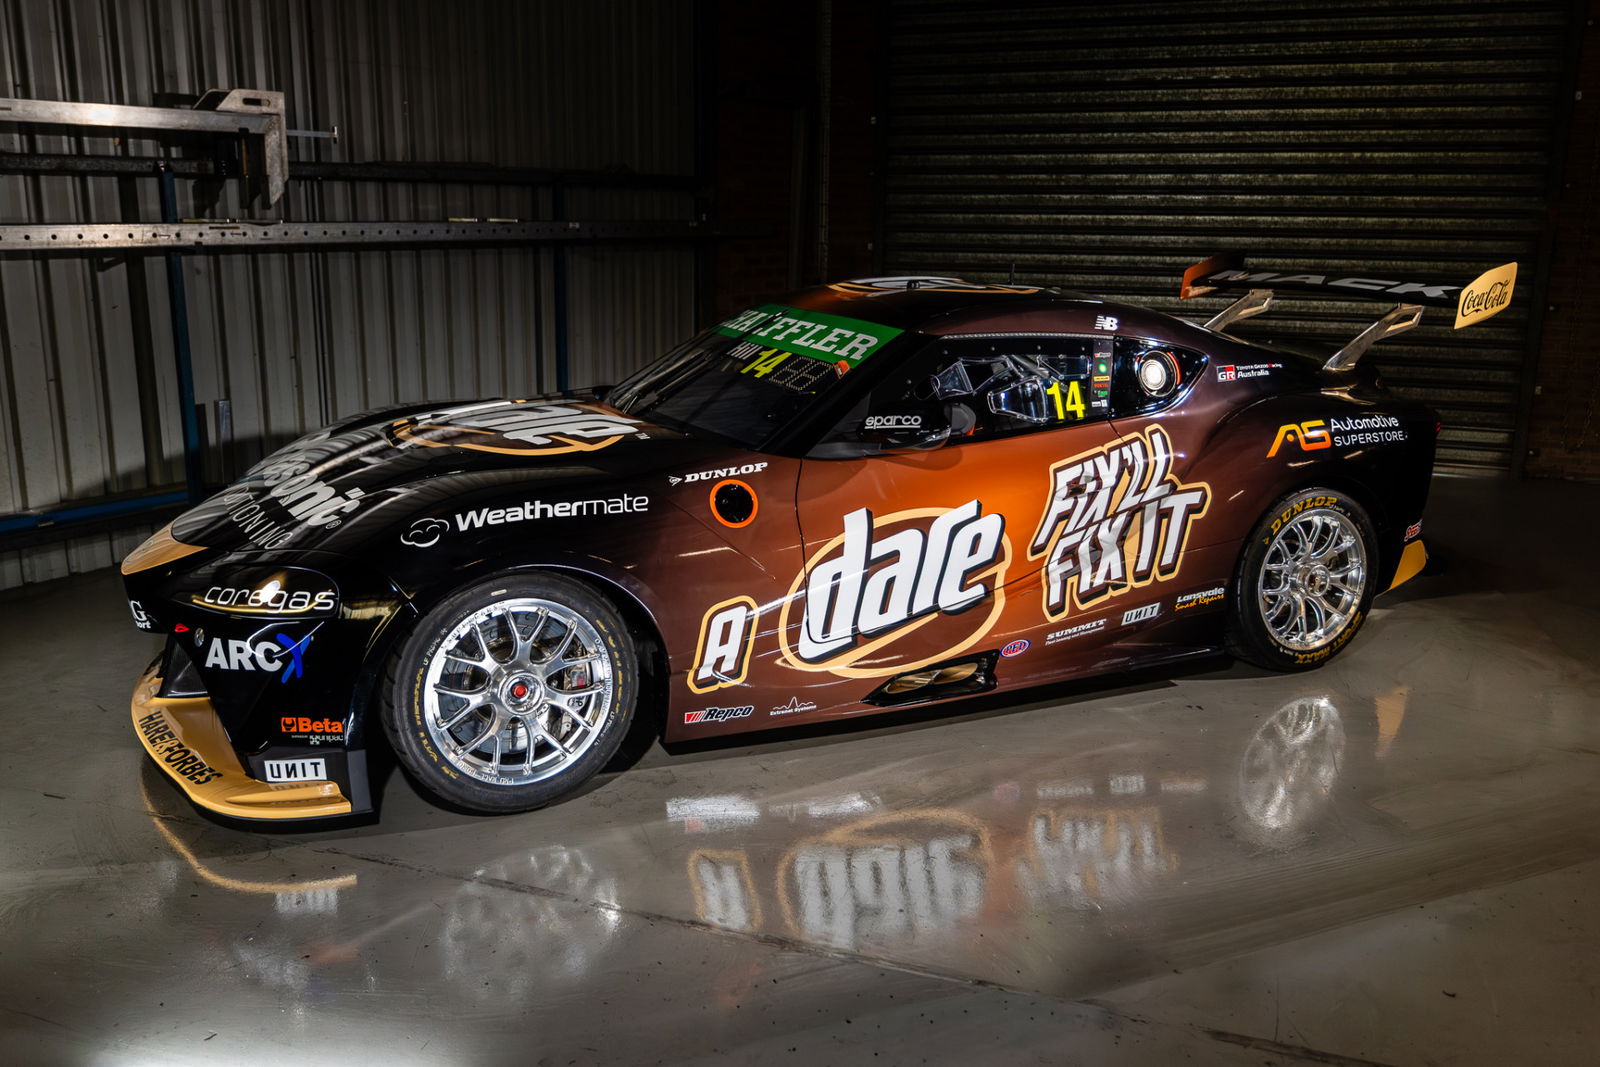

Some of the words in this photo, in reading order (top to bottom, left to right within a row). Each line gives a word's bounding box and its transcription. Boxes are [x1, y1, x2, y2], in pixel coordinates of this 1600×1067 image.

[1208, 270, 1461, 298] MACK
[740, 348, 792, 378] 14
[1218, 370, 1236, 381] GR
[1237, 369, 1269, 379] Australia
[1046, 381, 1085, 420] 14
[865, 413, 921, 431] sparco
[1331, 415, 1399, 432] Automotive
[1334, 430, 1404, 447] SUPERSTORE
[684, 462, 768, 483] DUNLOP
[455, 493, 649, 532] Weathermate
[1271, 496, 1337, 536] DUNLOP
[1049, 511, 1128, 607] FIX
[1135, 490, 1203, 573] IT
[204, 586, 335, 613] coregas
[1176, 587, 1224, 603] Lansvale
[1046, 618, 1107, 640] SUMMIT
[697, 605, 749, 686] A
[297, 716, 343, 733] Beta
[705, 706, 754, 722] Repco
